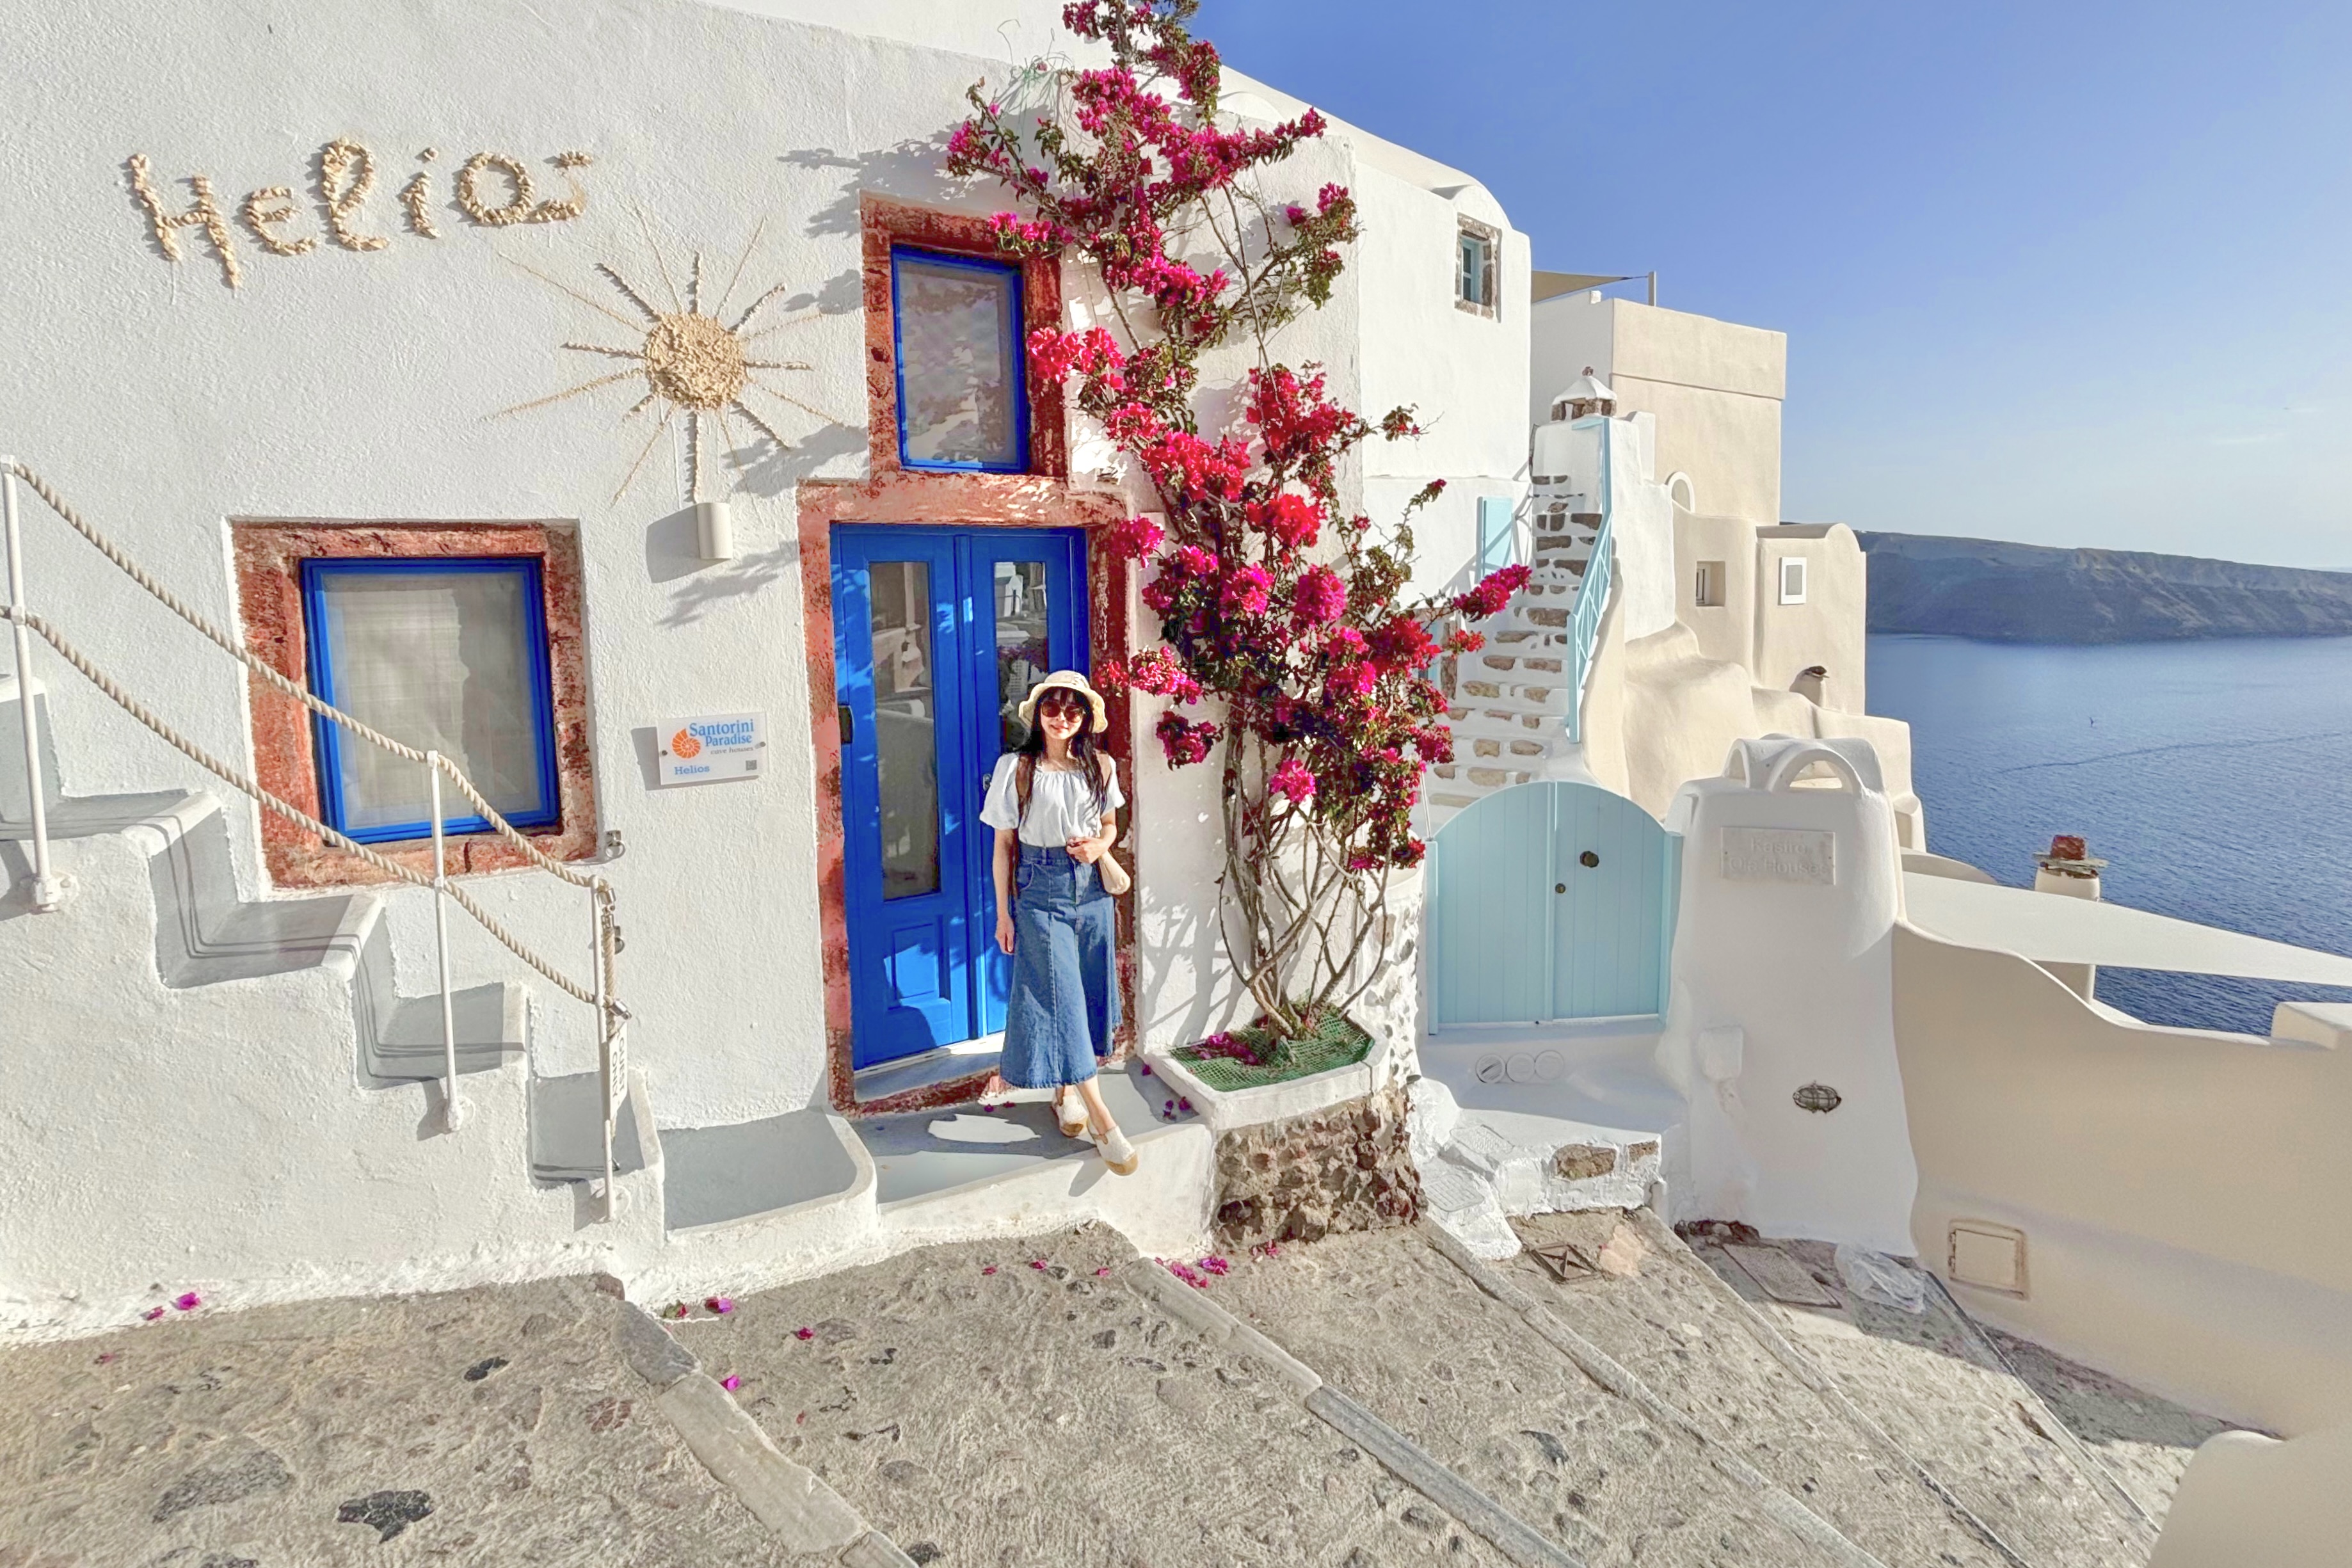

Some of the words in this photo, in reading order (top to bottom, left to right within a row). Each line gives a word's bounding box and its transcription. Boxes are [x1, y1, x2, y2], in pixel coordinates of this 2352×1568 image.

[129, 137, 594, 288] Helios
[689, 719, 754, 737] Santorini
[705, 733, 753, 747] Paradise
[674, 765, 710, 775] Helios
[1750, 837, 1806, 854] Kastro
[1764, 858, 1828, 876] Houses
